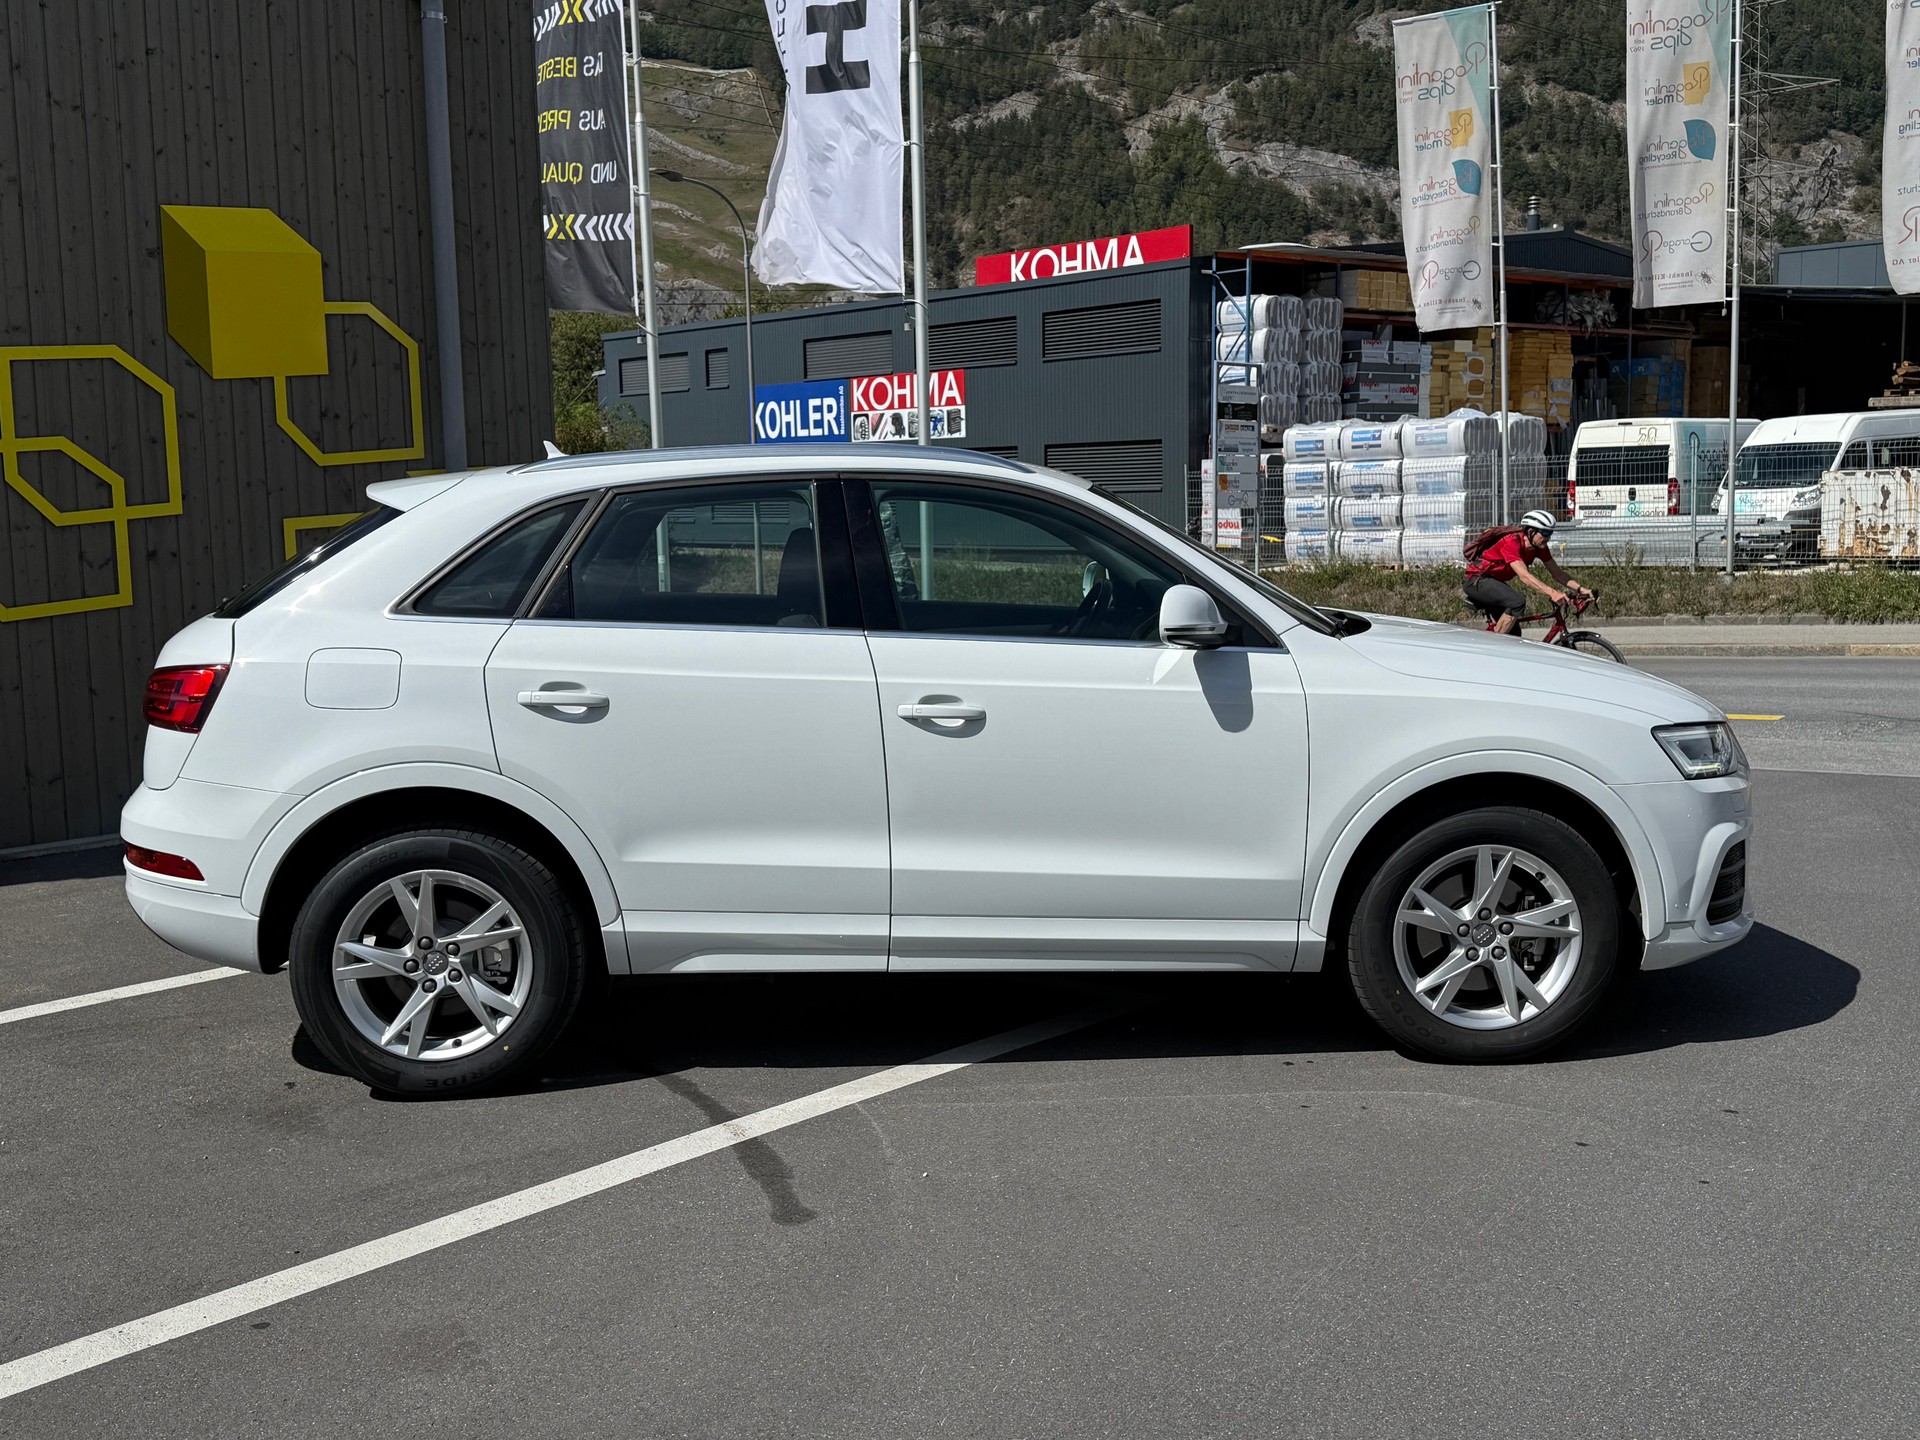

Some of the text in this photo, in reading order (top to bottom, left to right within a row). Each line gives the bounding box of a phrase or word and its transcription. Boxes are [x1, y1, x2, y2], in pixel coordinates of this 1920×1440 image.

[1010, 235, 1145, 282] KOHMA
[853, 371, 962, 412] KOHMA
[755, 397, 840, 439] KOHLER
